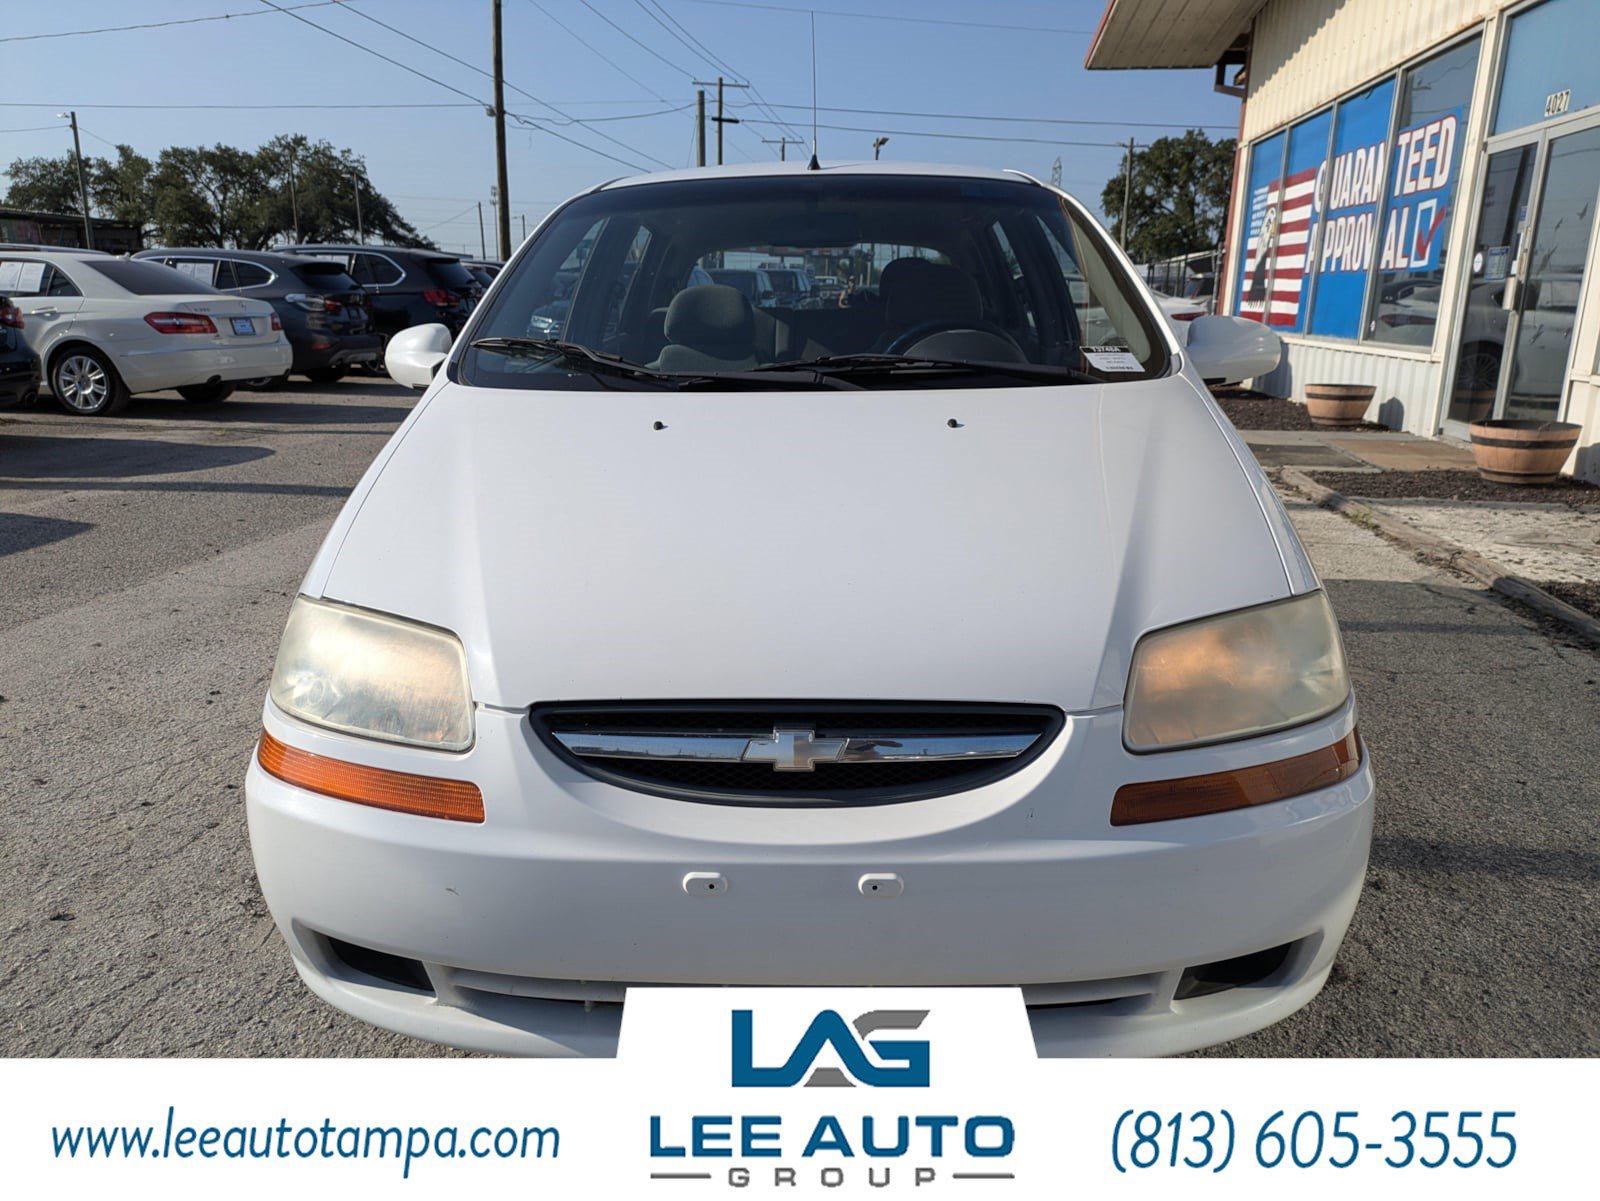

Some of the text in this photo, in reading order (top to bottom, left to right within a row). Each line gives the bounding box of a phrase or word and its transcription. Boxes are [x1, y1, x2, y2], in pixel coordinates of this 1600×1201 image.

[1546, 90, 1570, 115] 4027
[1314, 115, 1457, 213] GUARANTEED
[1304, 207, 1410, 275] APPROVAL
